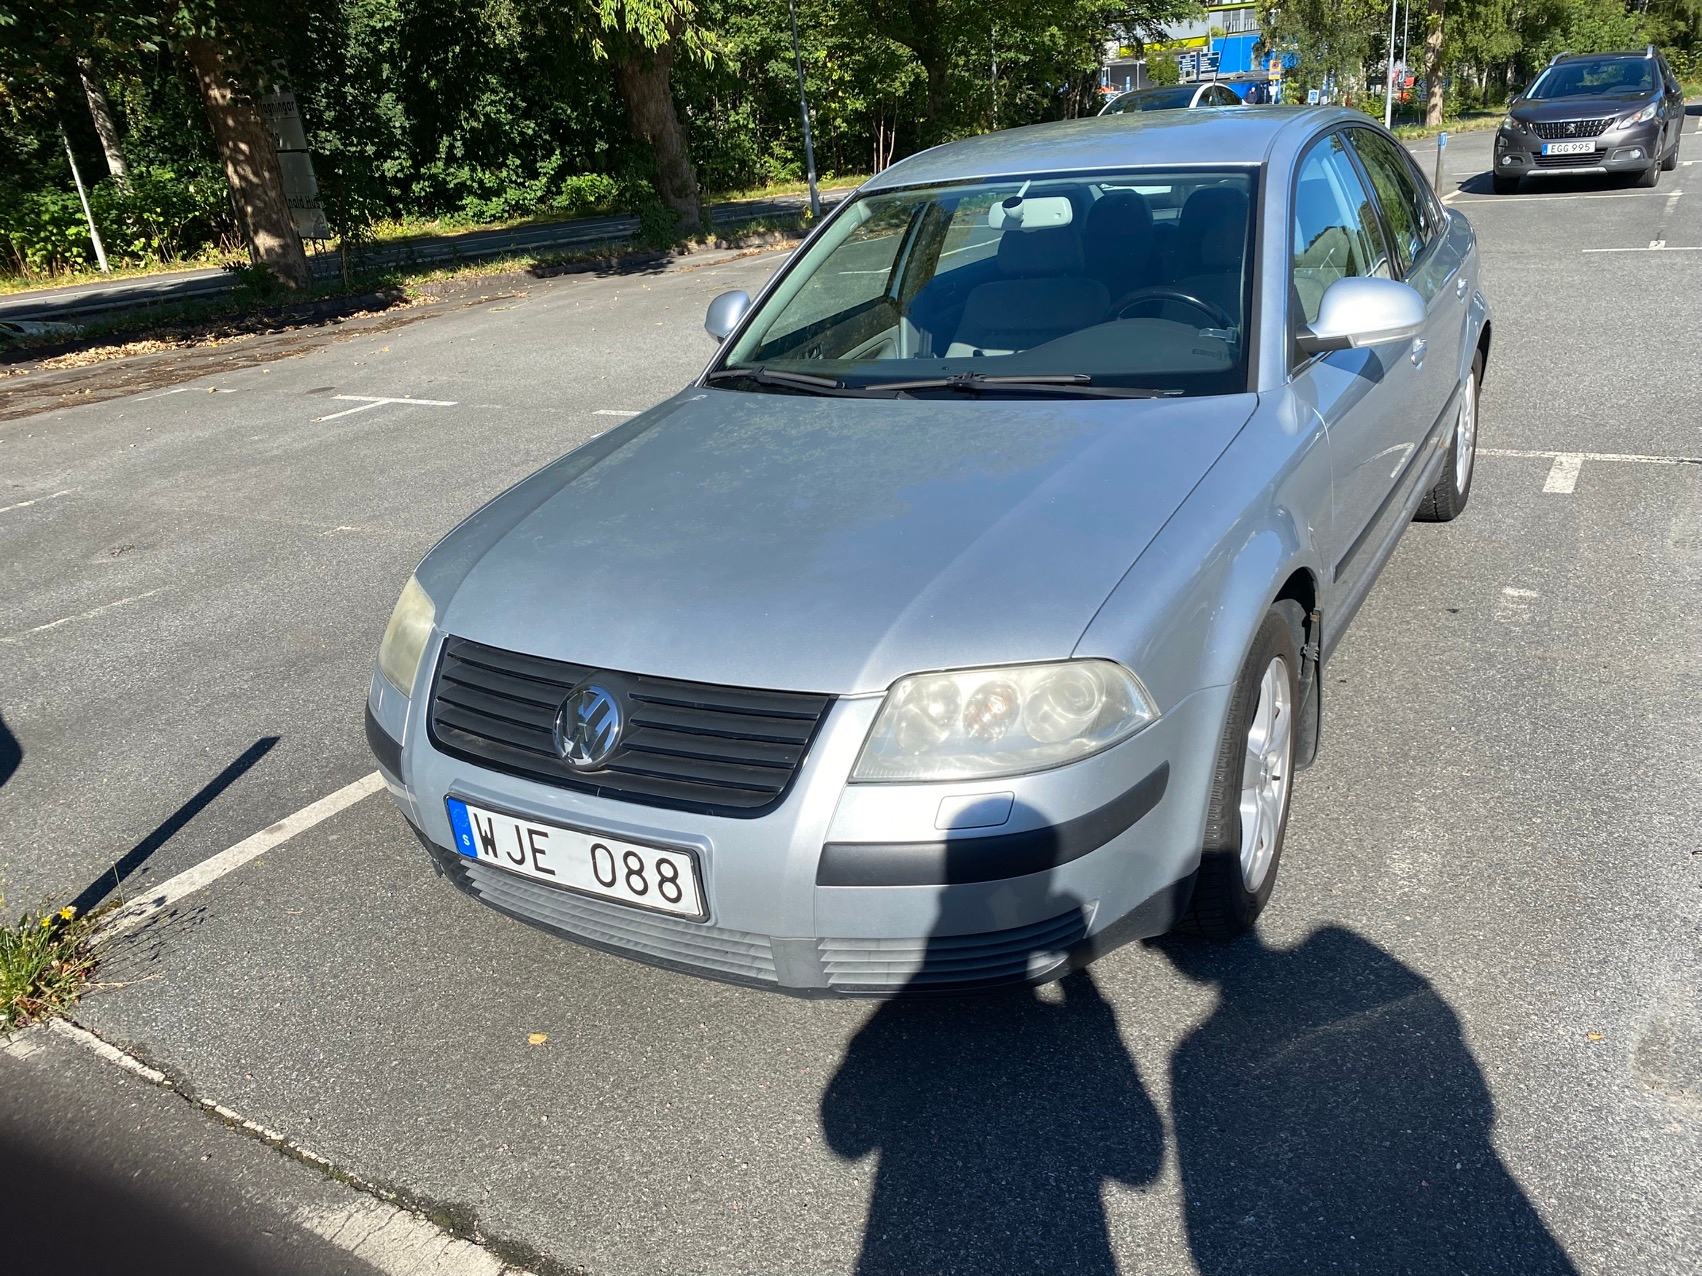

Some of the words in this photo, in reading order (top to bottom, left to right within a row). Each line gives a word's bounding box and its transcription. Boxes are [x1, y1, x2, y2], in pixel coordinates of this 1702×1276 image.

[1550, 144, 1569, 153] EGG
[1571, 143, 1591, 152] 995
[555, 686, 621, 767] VW
[462, 834, 470, 846] S
[473, 812, 556, 876] WJE
[590, 842, 683, 904] 088
